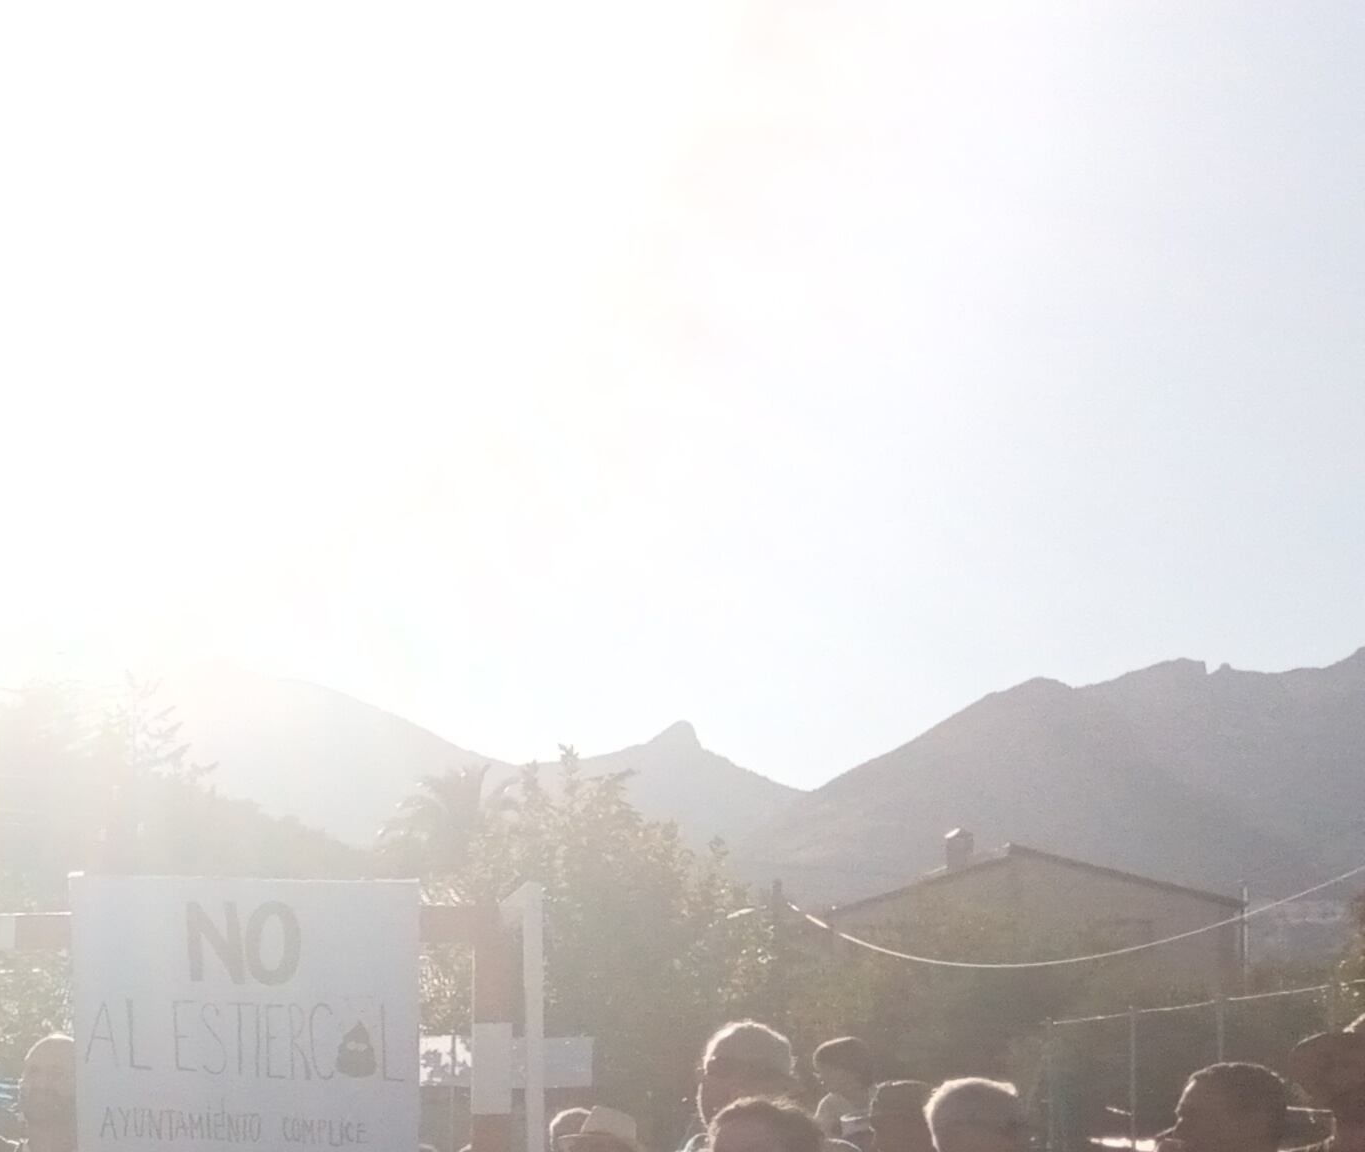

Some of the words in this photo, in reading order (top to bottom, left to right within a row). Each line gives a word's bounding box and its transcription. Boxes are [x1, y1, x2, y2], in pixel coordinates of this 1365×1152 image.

[186, 900, 302, 987] NO
[85, 998, 153, 1071] AL
[173, 1000, 406, 1083] ESTIERCL
[282, 1116, 370, 1148] COMPLICE
